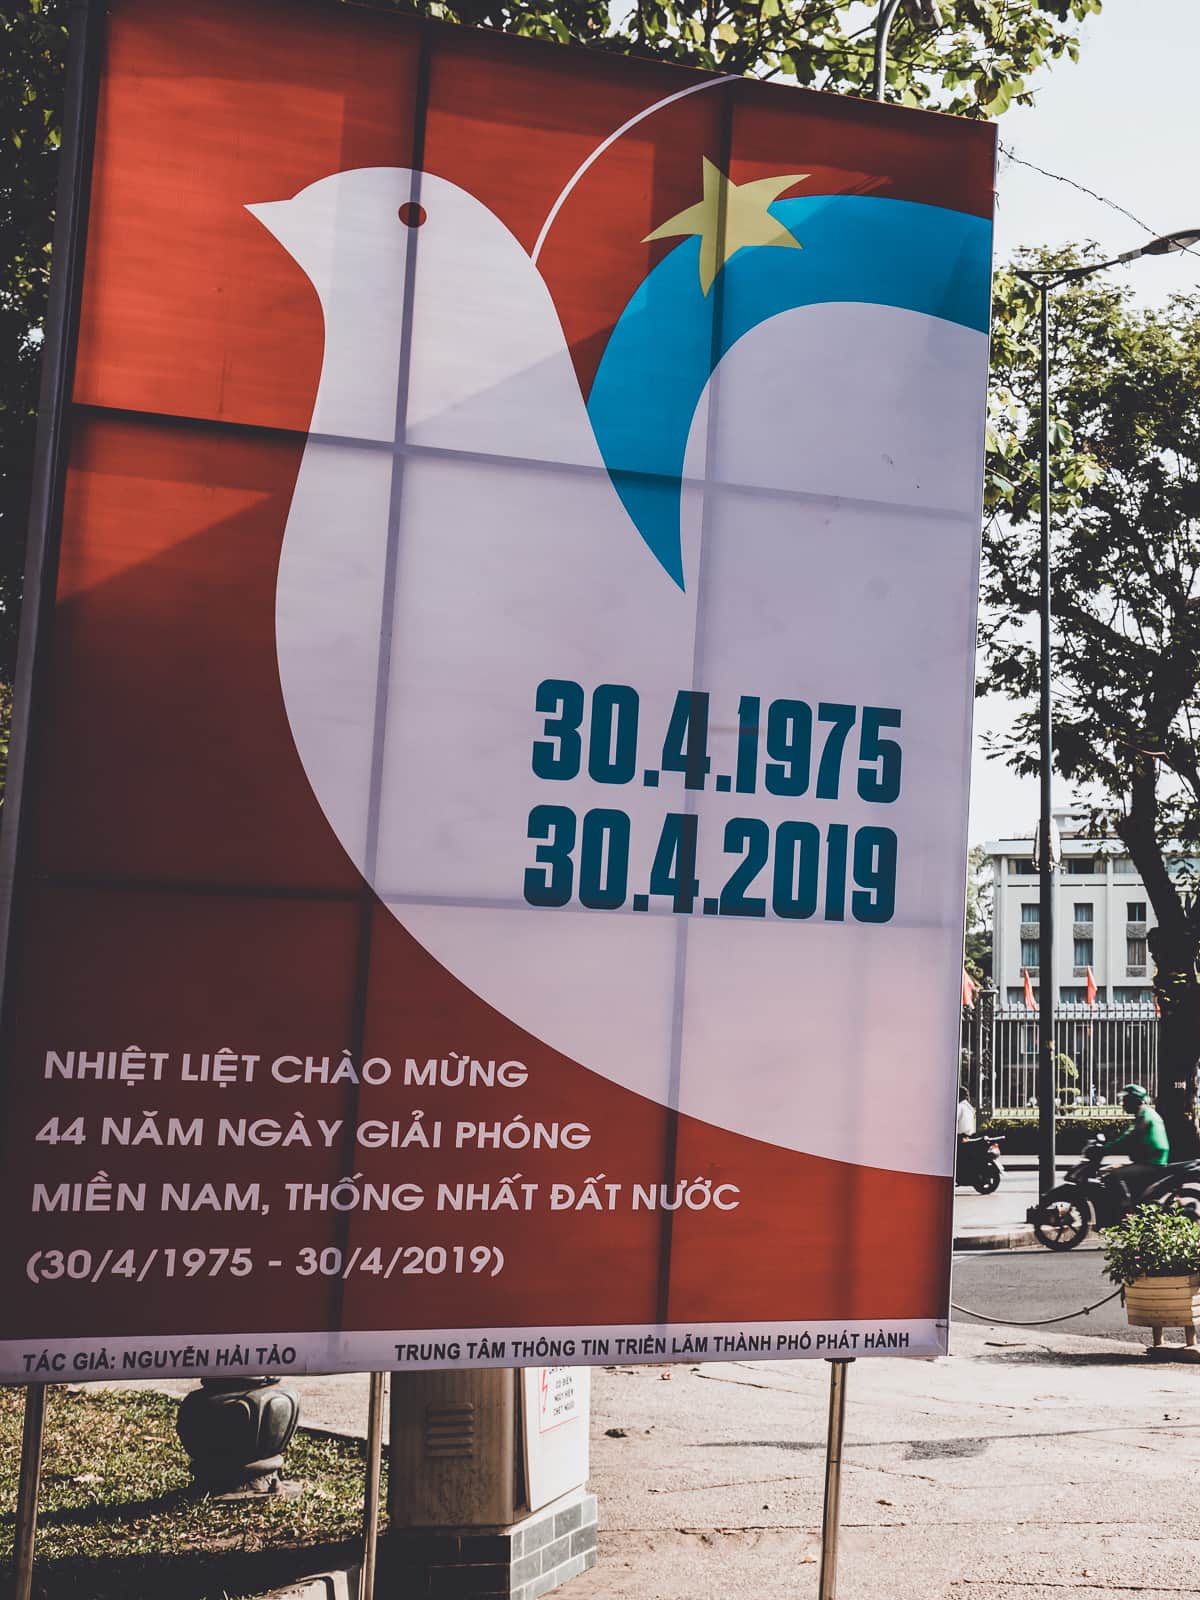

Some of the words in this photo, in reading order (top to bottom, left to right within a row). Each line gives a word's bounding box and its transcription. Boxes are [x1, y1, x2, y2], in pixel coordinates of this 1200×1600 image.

[531, 678, 902, 804] 30.4.1975
[523, 804, 898, 924] 30.4.2019
[44, 1045, 169, 1086] NHIỆT
[181, 1047, 260, 1088] LIỆT
[271, 1049, 391, 1085] CHÀO
[403, 1051, 529, 1088] MỪNG
[35, 1117, 86, 1145] 44
[101, 1111, 203, 1146] NĂM
[217, 1112, 343, 1148] NGÀY
[356, 1110, 442, 1148] GIẢI
[455, 1115, 591, 1149] PHÓNG
[31, 1170, 146, 1212] MIỀN
[160, 1184, 270, 1216] NAM,
[285, 1172, 425, 1212] THỐNG
[436, 1173, 538, 1212] NHẤT
[550, 1174, 622, 1211] ĐẤT
[632, 1177, 741, 1211] NƯỚC
[25, 1247, 254, 1285] (30/4/1975
[295, 1245, 504, 1279] 30/4/2019)
[23, 1349, 66, 1372] TÁC
[122, 1345, 209, 1369] NGUYỄN
[394, 1342, 461, 1361] TRUNG
[466, 1338, 506, 1360] TÂM
[511, 1336, 576, 1358] THÔNG
[581, 1339, 609, 1356] TIN
[671, 1333, 708, 1354] LÃM
[713, 1331, 772, 1352] THÀNH
[776, 1330, 812, 1351] PHỐ
[816, 1329, 860, 1350] PHÁT
[864, 1328, 910, 1349] HÀNH
